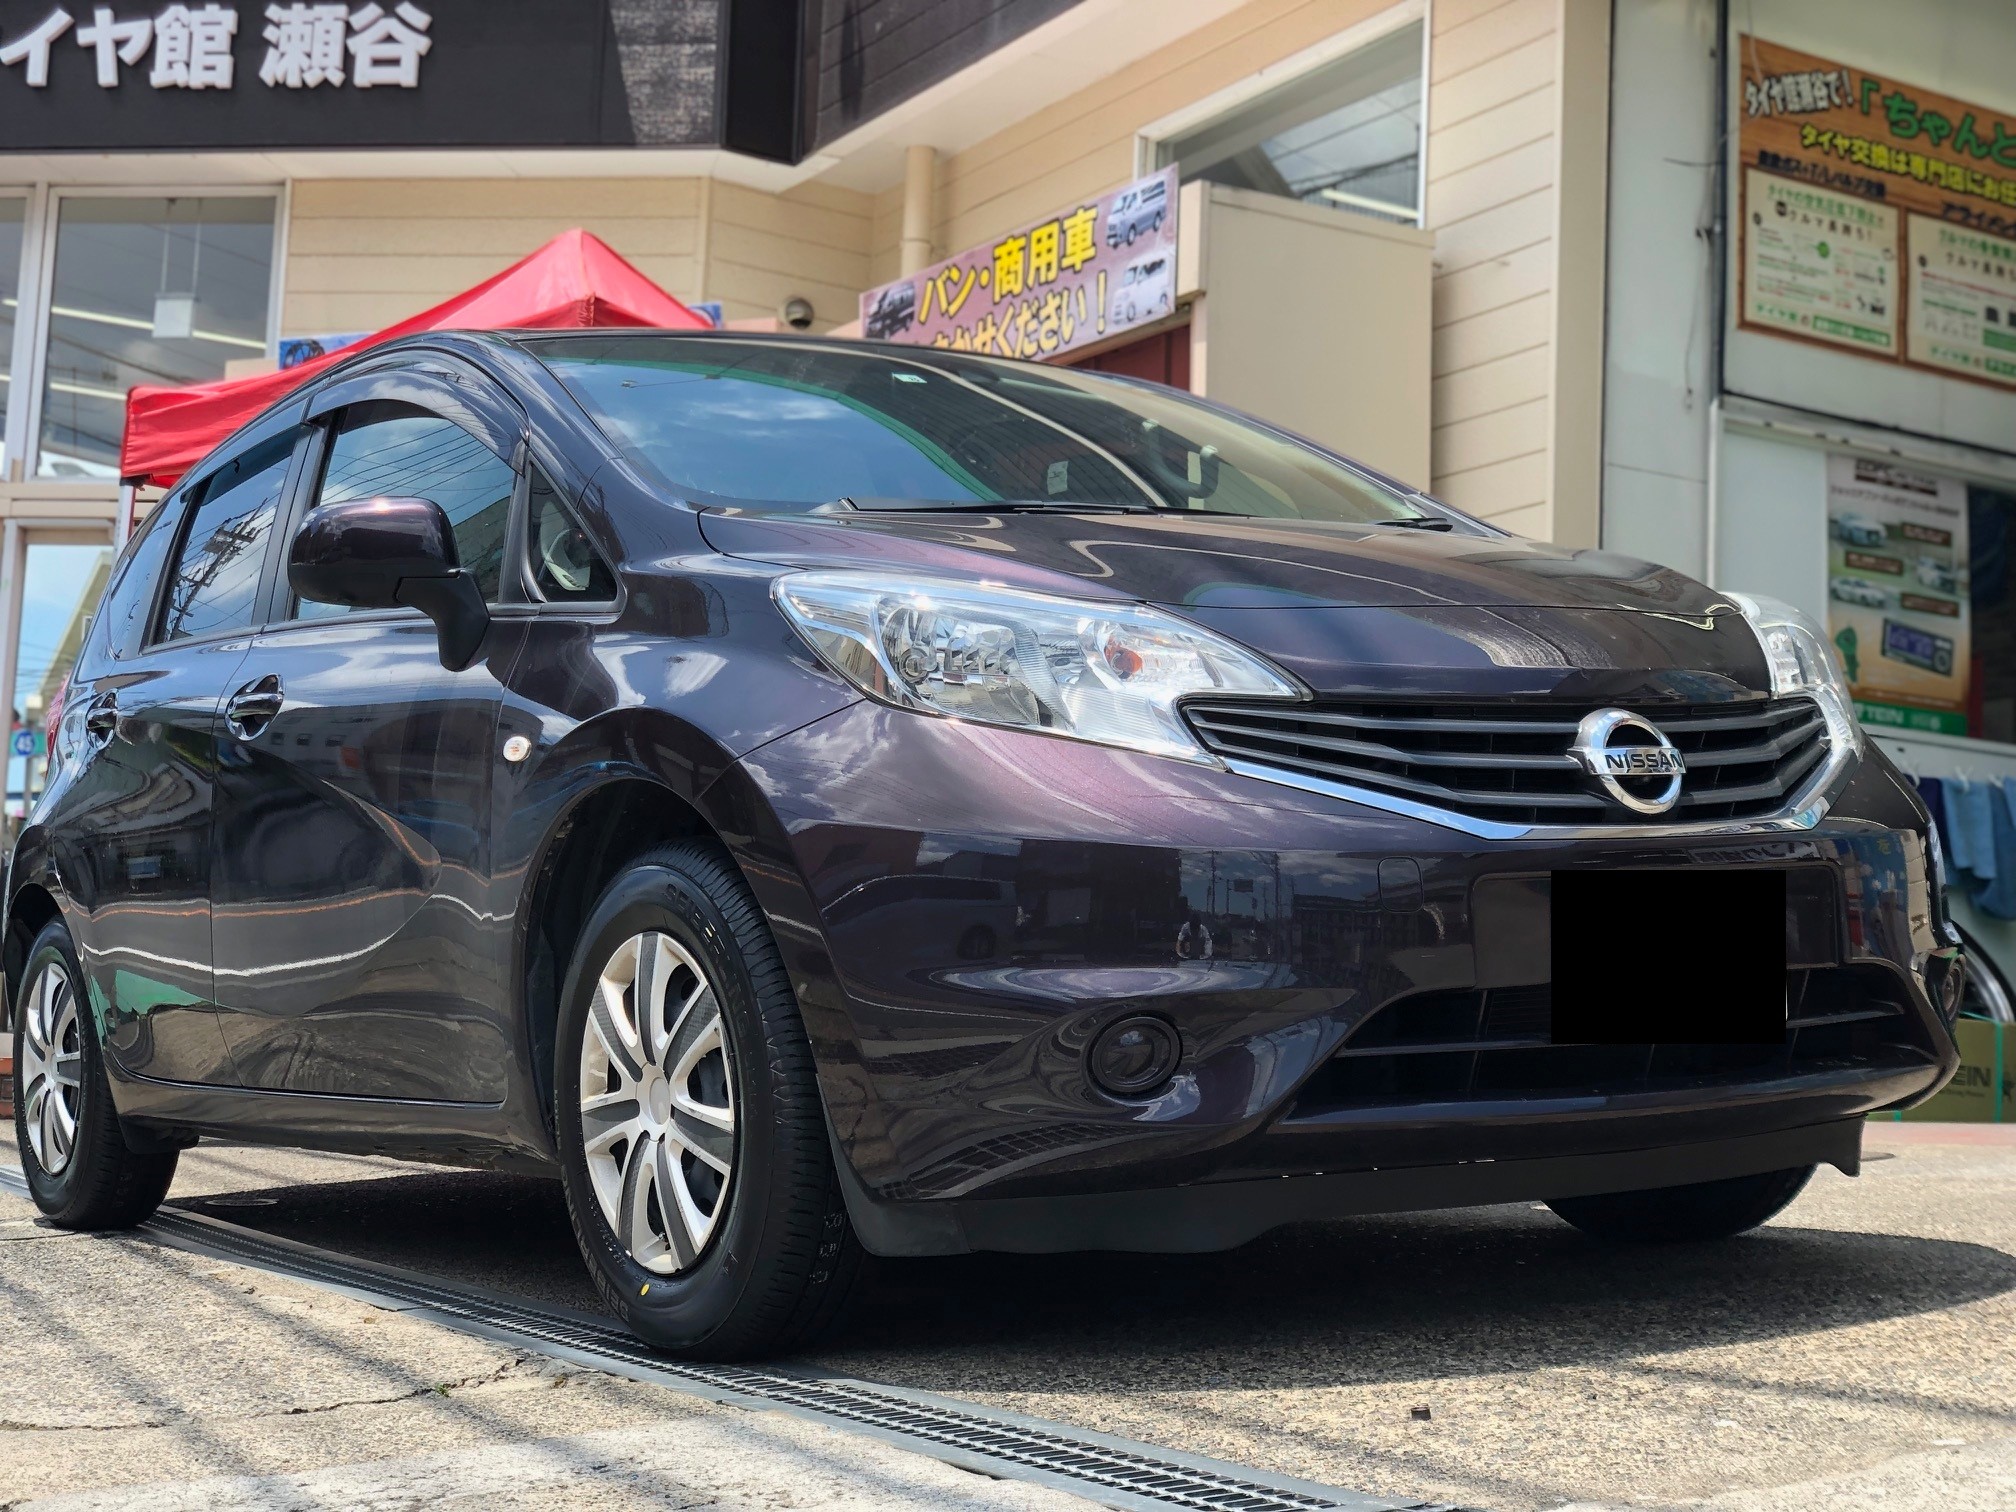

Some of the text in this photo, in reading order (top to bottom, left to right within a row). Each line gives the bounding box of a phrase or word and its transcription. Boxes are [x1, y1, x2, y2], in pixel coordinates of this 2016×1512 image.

[0, 2, 432, 89] イヤ館 瀬谷
[917, 204, 1098, 324] バン・商用車
[914, 272, 1107, 358] まかせください!
[1604, 753, 1683, 769] NISSAN
[1951, 1065, 1991, 1087] EIN
